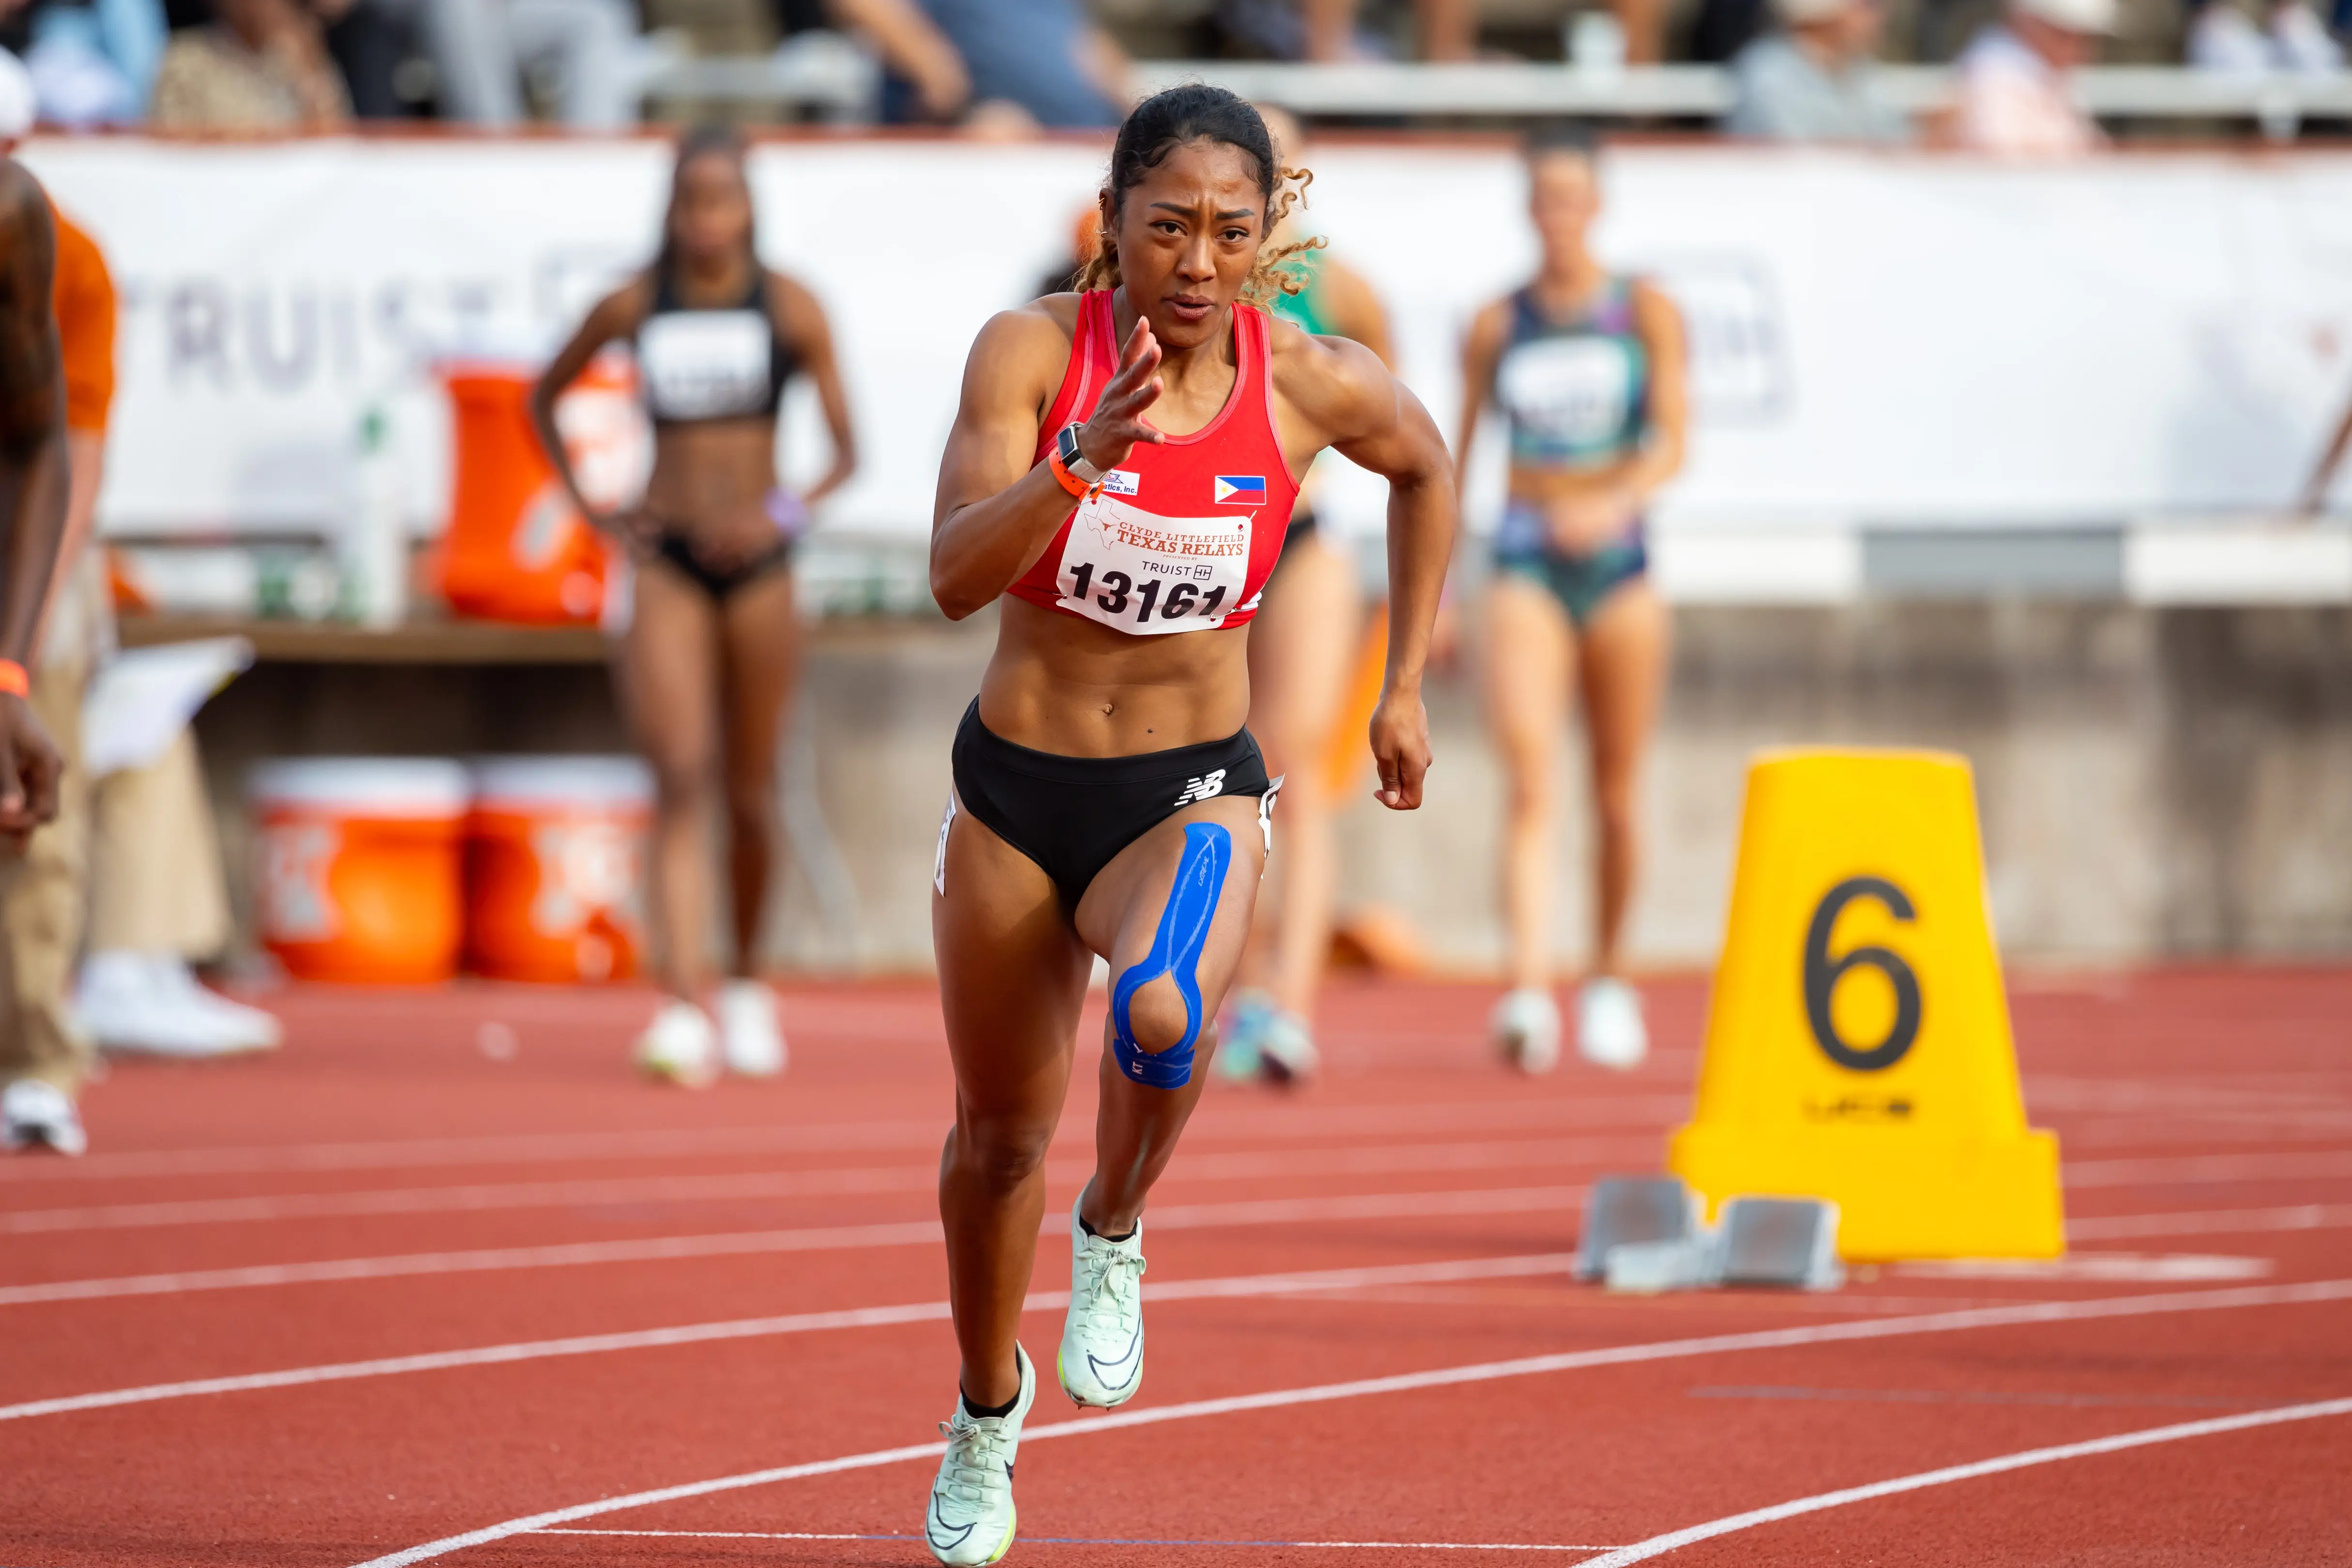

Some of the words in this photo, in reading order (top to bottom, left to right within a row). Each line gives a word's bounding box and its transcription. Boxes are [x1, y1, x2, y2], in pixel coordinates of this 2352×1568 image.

[1124, 486, 1137, 494] Inc.
[1117, 529, 1178, 553] TEXAS
[1180, 543, 1244, 556] RELAYS
[1119, 521, 1162, 539] CLYDE
[1166, 533, 1244, 543] LITTLEFIELD
[1142, 561, 1192, 576] TRUIST
[1070, 562, 1227, 623] 13161
[1174, 769, 1226, 806] NB
[1802, 874, 1922, 1072] 6
[1132, 1061, 1143, 1075] KT
